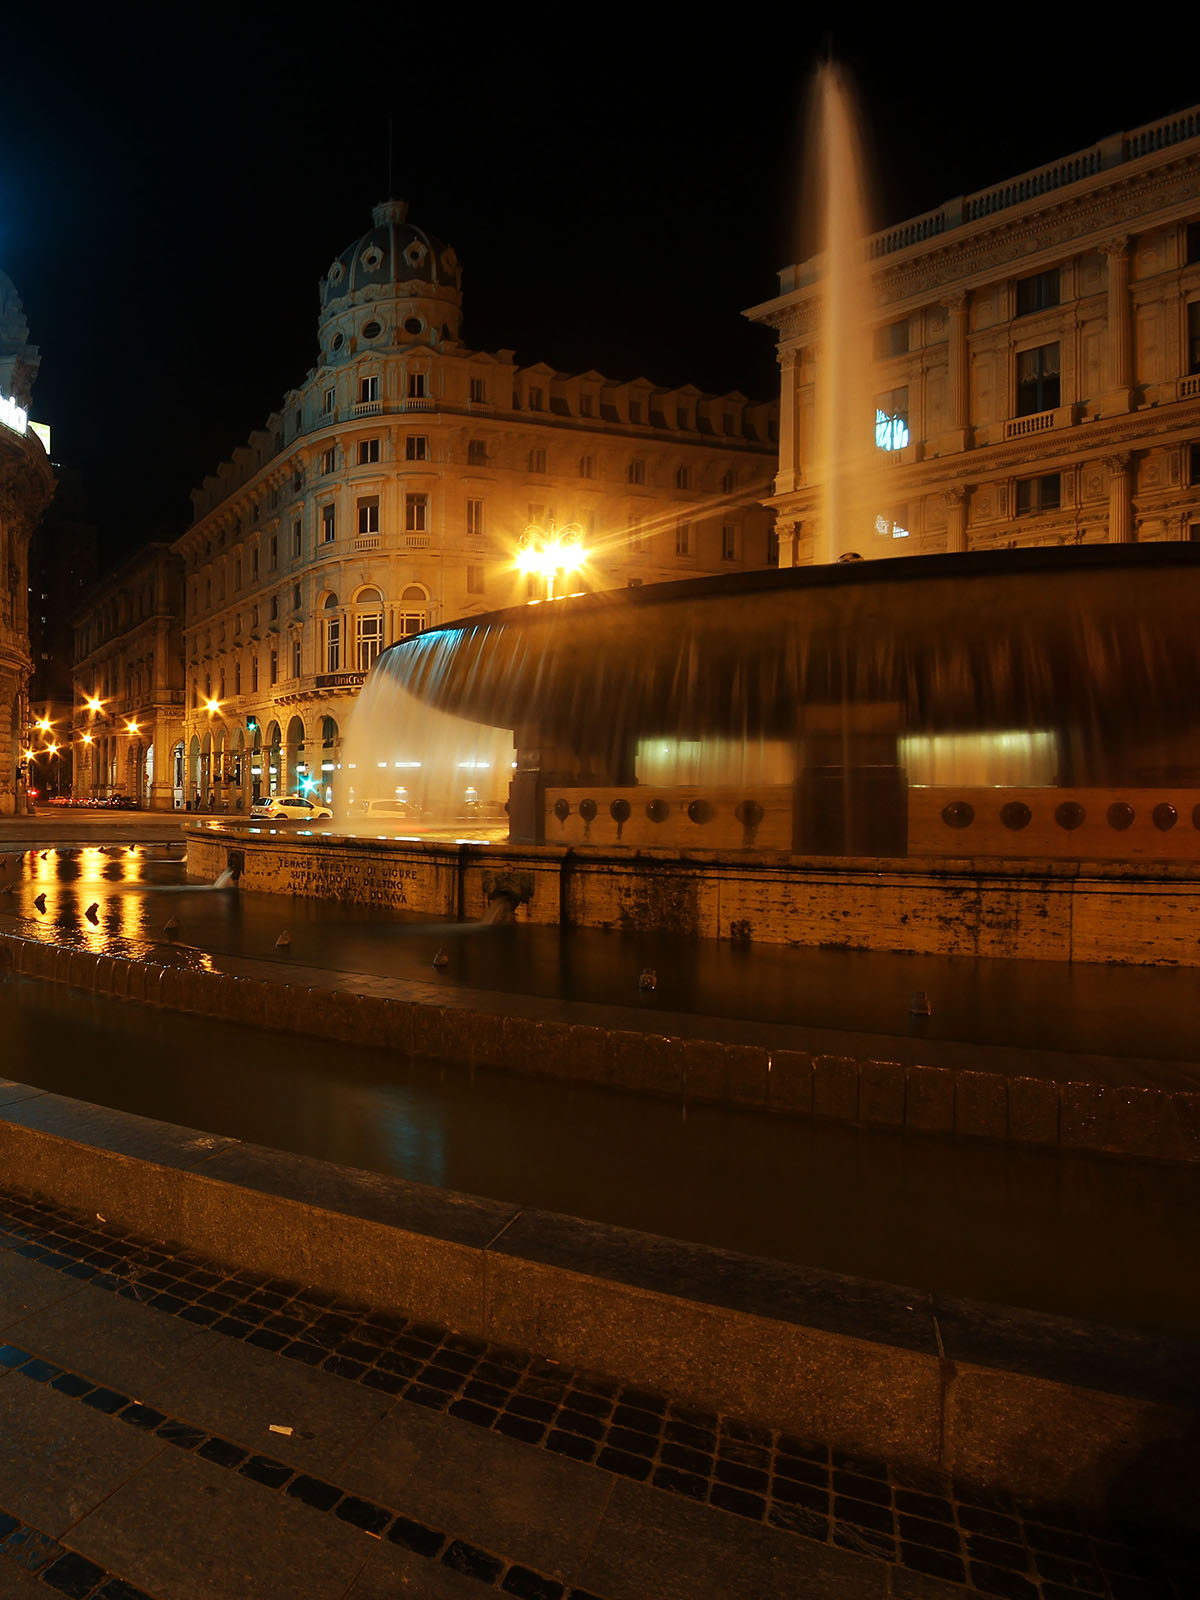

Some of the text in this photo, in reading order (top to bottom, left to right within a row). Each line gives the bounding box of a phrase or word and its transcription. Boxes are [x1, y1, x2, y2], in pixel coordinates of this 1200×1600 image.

[279, 858, 313, 869] TENACE
[367, 866, 376, 876] DI
[382, 868, 417, 879] LIGURE
[287, 881, 309, 892] ALLA
[363, 878, 404, 890] DESTINO
